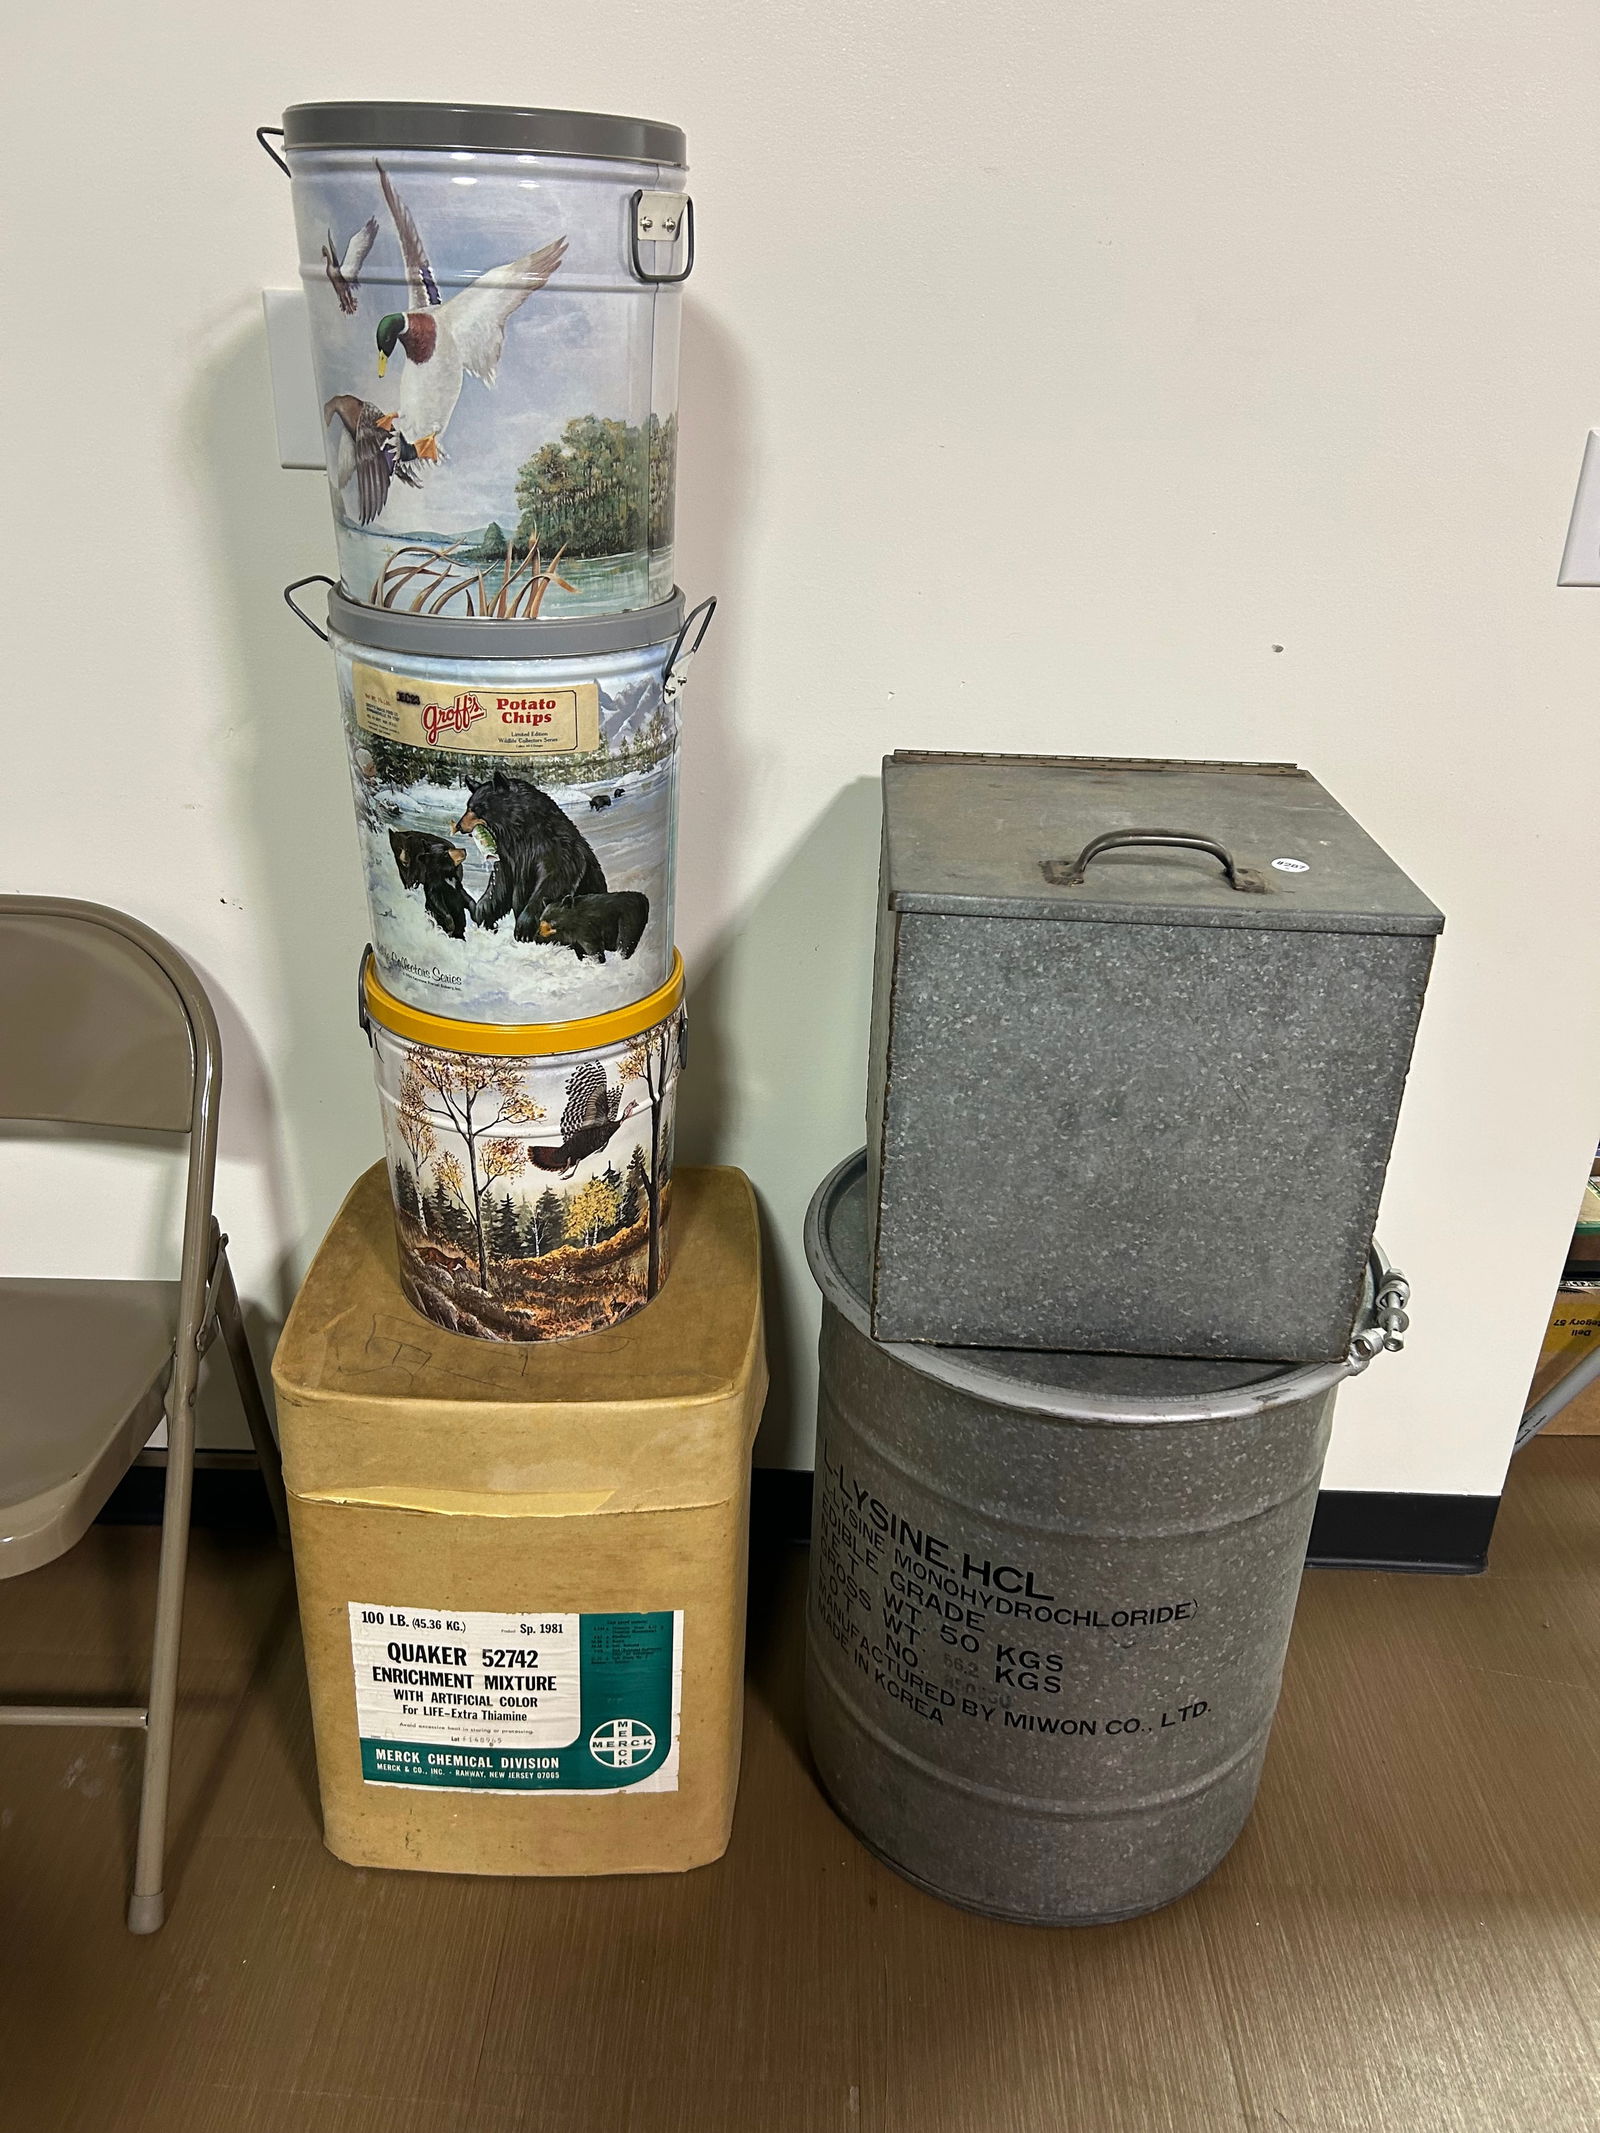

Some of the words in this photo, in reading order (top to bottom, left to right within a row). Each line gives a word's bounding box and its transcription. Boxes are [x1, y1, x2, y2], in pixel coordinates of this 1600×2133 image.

[496, 698, 557, 711] Potato
[501, 711, 552, 727] Chips
[432, 966, 462, 985] Series
[822, 1491, 879, 1575] EDIBLE
[890, 1570, 985, 1633] GRADE
[361, 1611, 384, 1625] 100
[389, 1613, 409, 1627] LB.
[412, 1617, 442, 1631] (45.36
[446, 1620, 466, 1633] KG.)
[820, 1534, 872, 1612] GROSS
[883, 1607, 927, 1653] WT.
[995, 1665, 1061, 1693] KGS
[519, 1623, 536, 1635] Sp.
[539, 1623, 564, 1634] 1981
[884, 1586, 927, 1632] WT.
[940, 1623, 980, 1653] 50
[996, 1643, 1064, 1672] KGS
[387, 1641, 467, 1667] QUAKER
[482, 1648, 539, 1668] 52742
[886, 1633, 926, 1675] NO.
[372, 1665, 474, 1690] ENRICHMENT
[484, 1675, 557, 1692] MIXTURE
[854, 1648, 869, 1675] IN
[875, 1667, 944, 1726] KOREA
[393, 1688, 424, 1702] WITH
[431, 1692, 494, 1707] ARTIFICIAL
[499, 1696, 538, 1708] COLOR
[403, 1705, 418, 1716] For
[481, 1710, 528, 1722] Thiamine
[962, 1697, 996, 1722] BY
[1004, 1710, 1097, 1736] MIWON
[1105, 1717, 1153, 1736] CO.,
[1161, 1700, 1212, 1728] LTD.
[592, 1738, 653, 1749] MERCK
[375, 1748, 420, 1763] MERCK
[427, 1753, 493, 1768] CHEMICAL
[501, 1756, 560, 1769] DIVISION
[377, 1763, 401, 1772] MERCK
[404, 1764, 410, 1773] &
[430, 1768, 446, 1776] INC.
[489, 1771, 505, 1779] NEW
[508, 1771, 534, 1779] JERSEY
